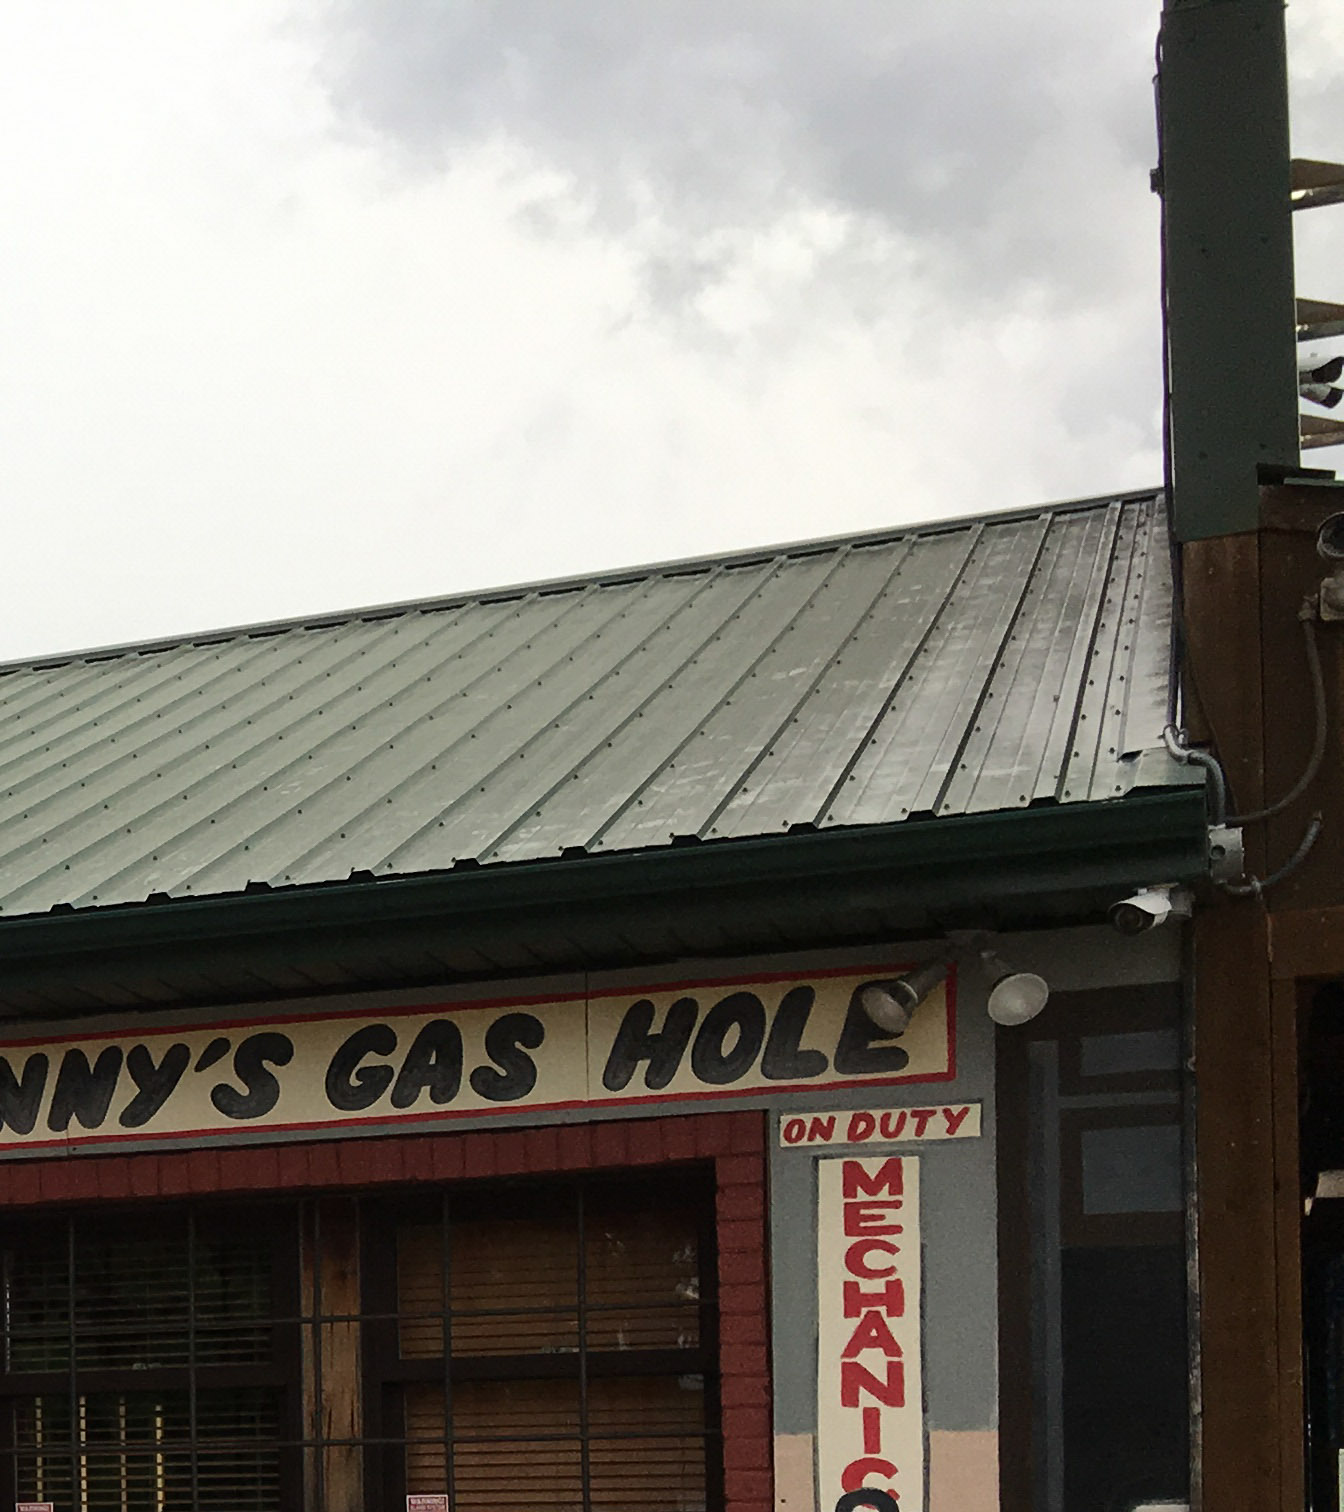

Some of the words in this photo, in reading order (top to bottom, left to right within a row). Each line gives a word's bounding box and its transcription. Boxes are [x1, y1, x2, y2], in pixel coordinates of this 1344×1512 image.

[324, 1013, 546, 1111] GAS
[603, 978, 910, 1092] HOLE
[783, 1116, 837, 1144] ON
[847, 1106, 971, 1142] DUTY
